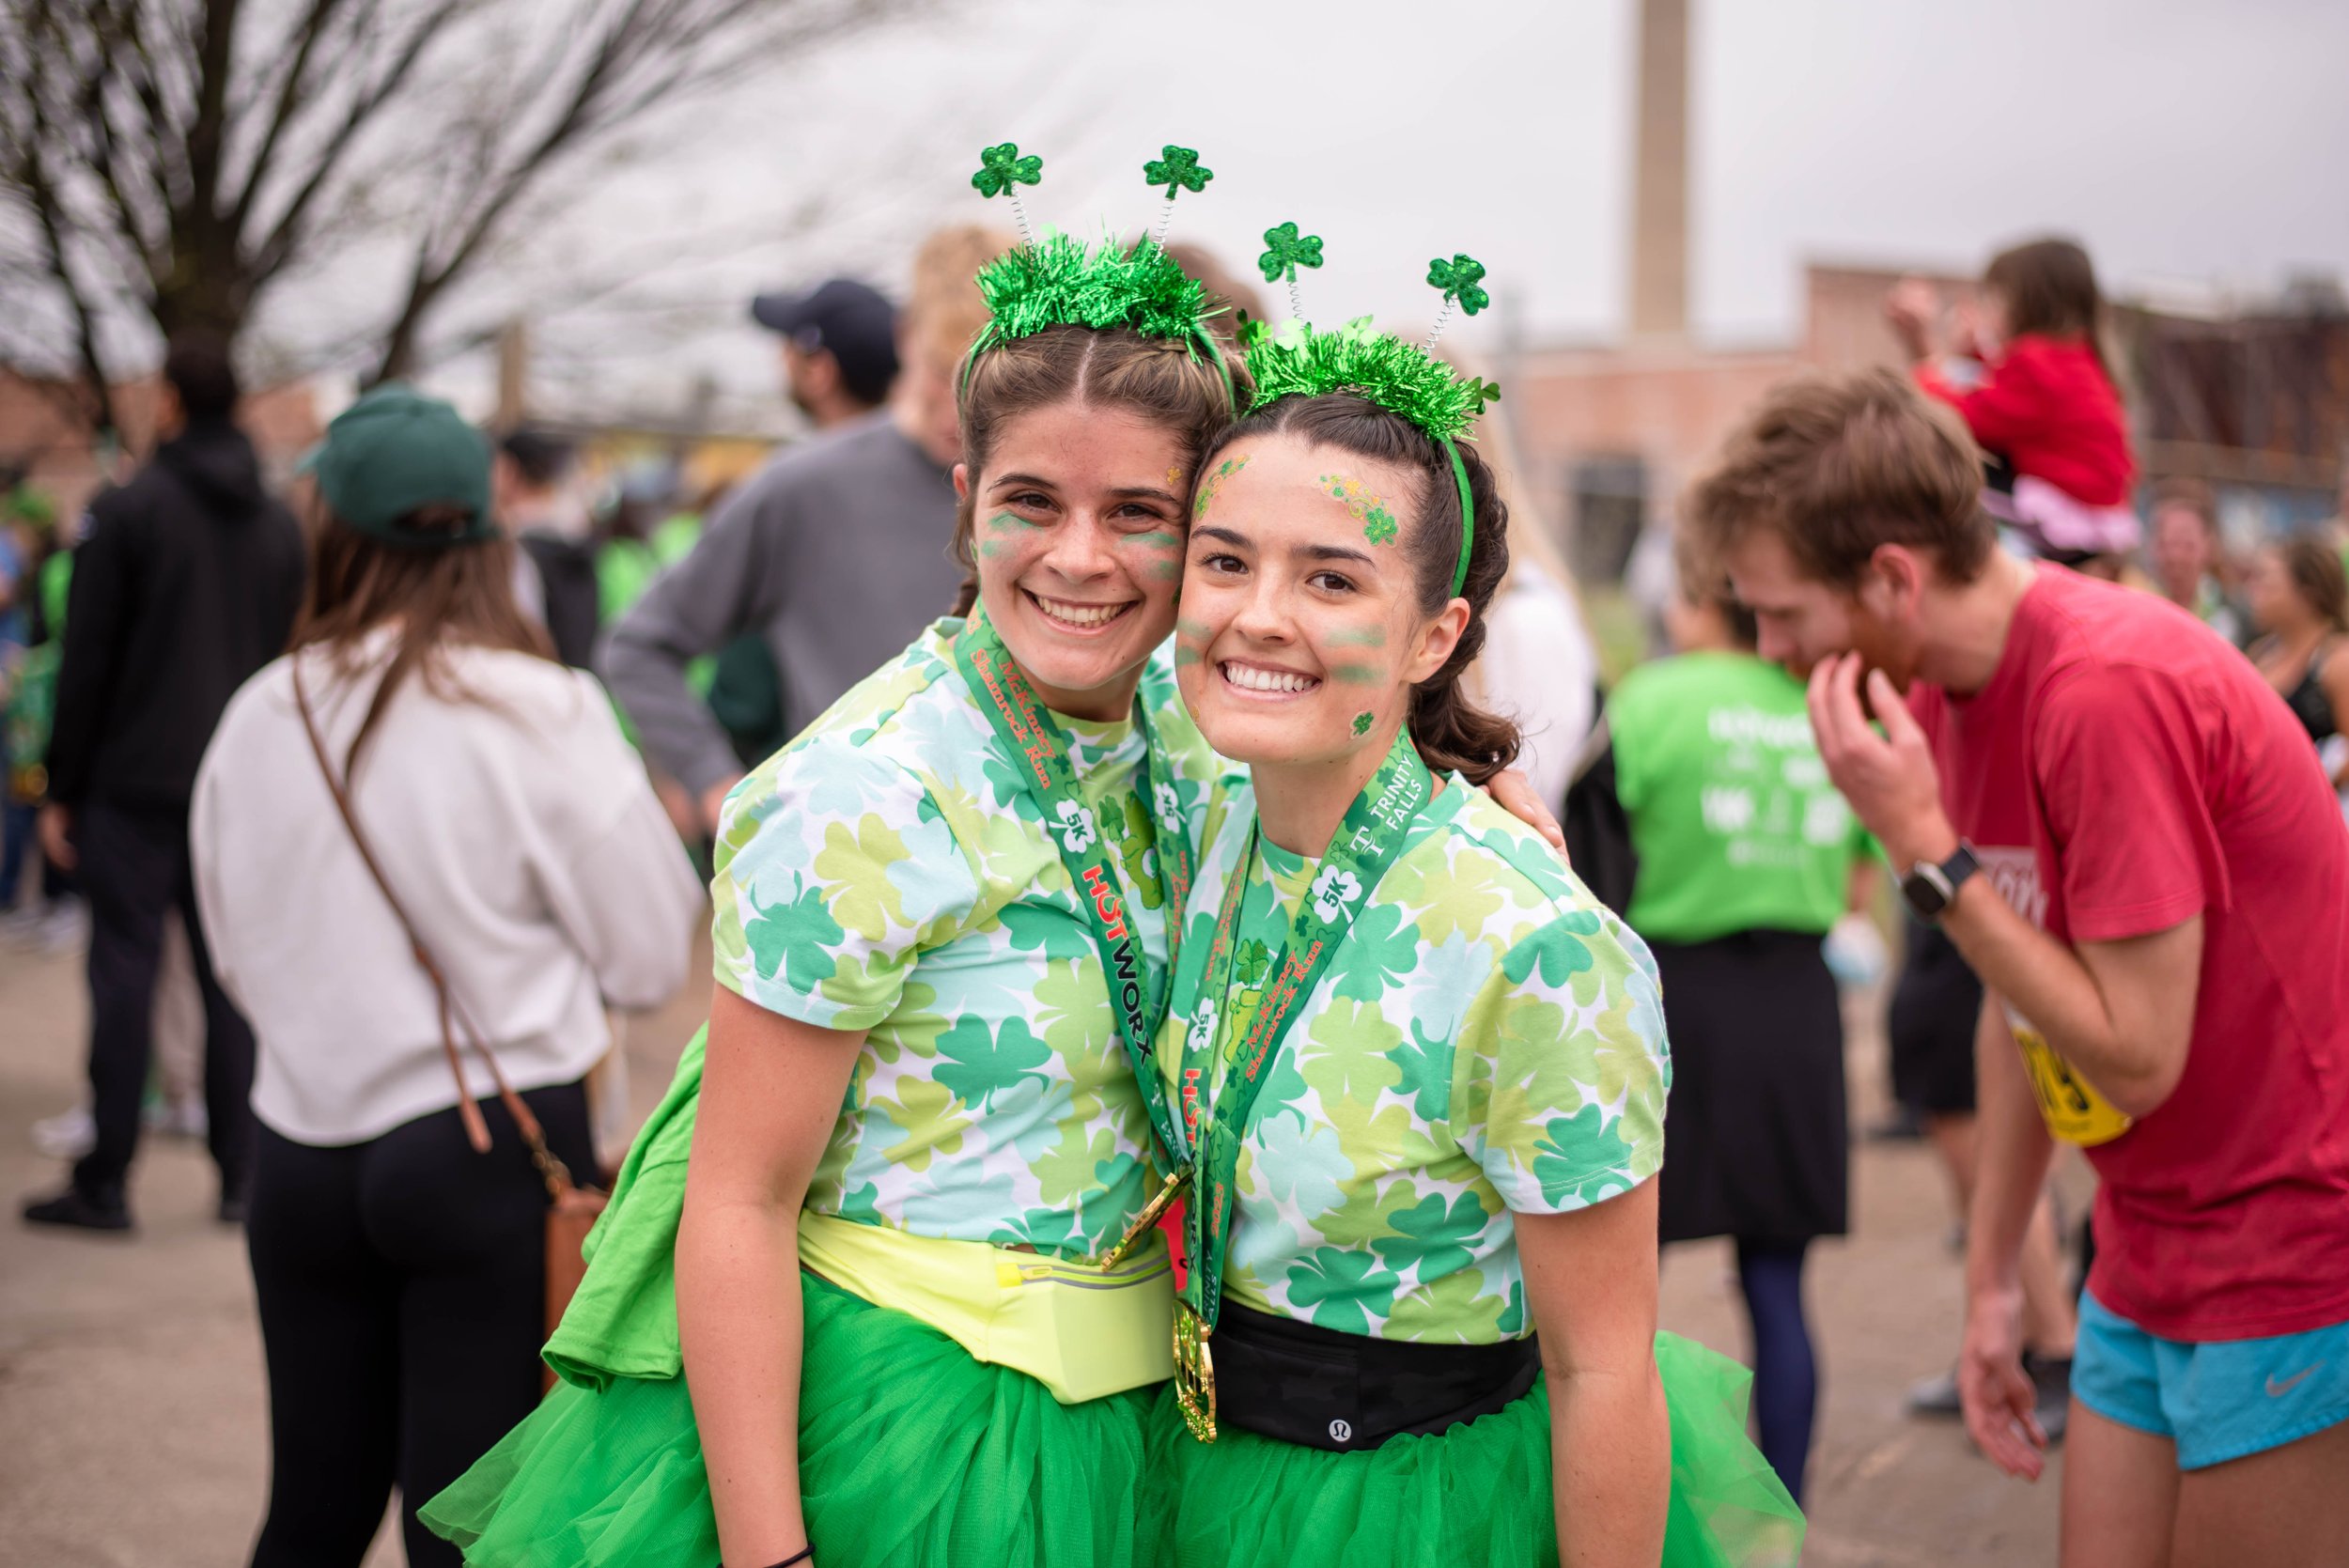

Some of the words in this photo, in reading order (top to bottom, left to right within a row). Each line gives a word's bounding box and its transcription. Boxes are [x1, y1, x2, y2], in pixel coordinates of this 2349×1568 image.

[971, 648, 1029, 744] Shamrock
[1025, 744, 1051, 789] Run
[999, 660, 1056, 759] McKinney
[1370, 753, 1414, 819] TRINITY
[1386, 778, 1423, 831] FALLS
[1066, 813, 1088, 842] 5K
[1322, 877, 1348, 908] 5K
[1196, 1014, 1210, 1040] 5K
[1246, 985, 1299, 1082] Shamrock
[1293, 939, 1323, 983] Run
[1248, 950, 1298, 1052] McKinney
[1210, 1182, 1223, 1240] 2023
